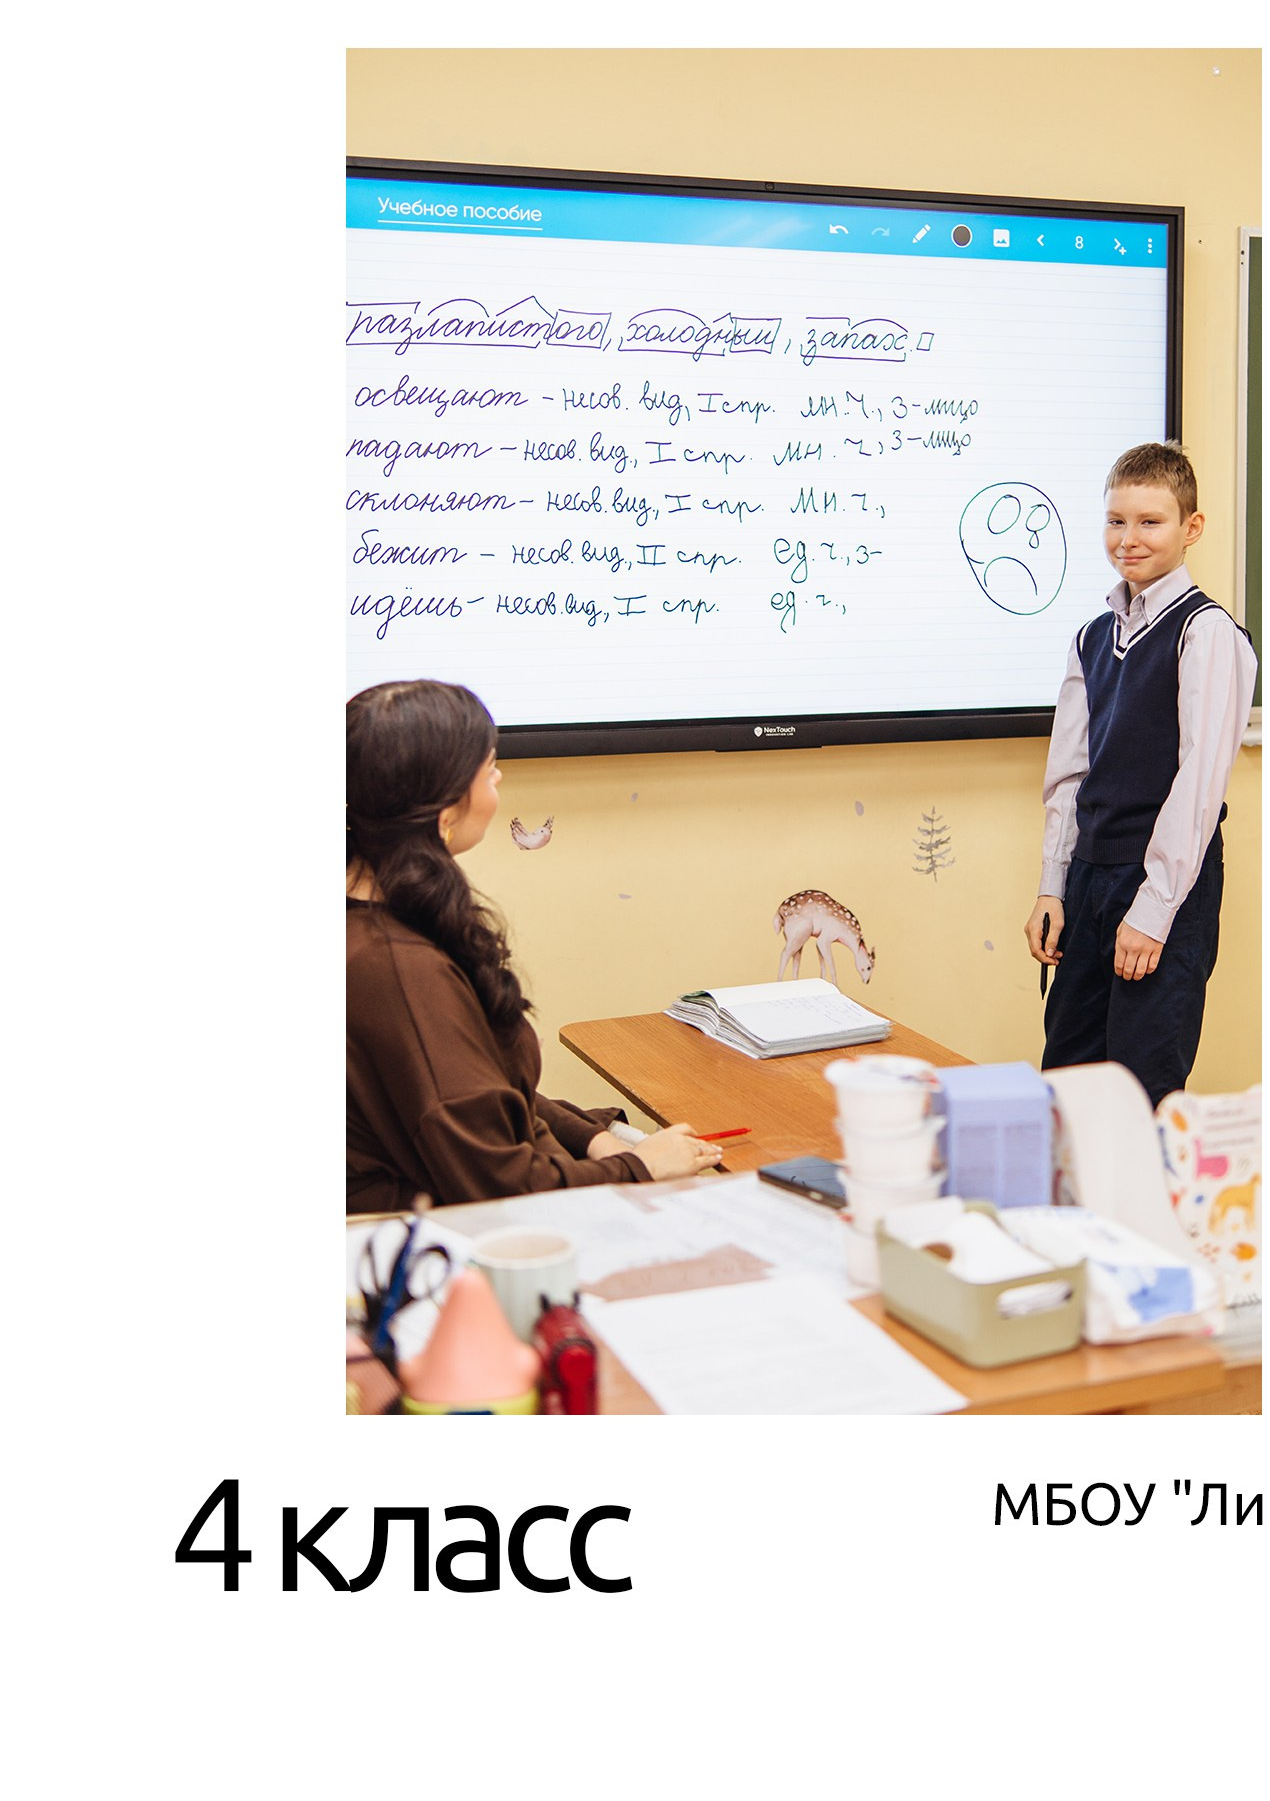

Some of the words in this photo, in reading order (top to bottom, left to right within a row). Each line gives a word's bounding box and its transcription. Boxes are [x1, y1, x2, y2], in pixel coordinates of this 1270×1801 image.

[377, 196, 458, 218] Учебное
[463, 204, 543, 223] пособие
[1074, 235, 1084, 249] 8
[354, 374, 529, 418] освещают
[346, 438, 493, 478] падают
[346, 489, 516, 512] склоняют
[353, 528, 468, 566] бежит
[763, 726, 796, 734] NexTouch
